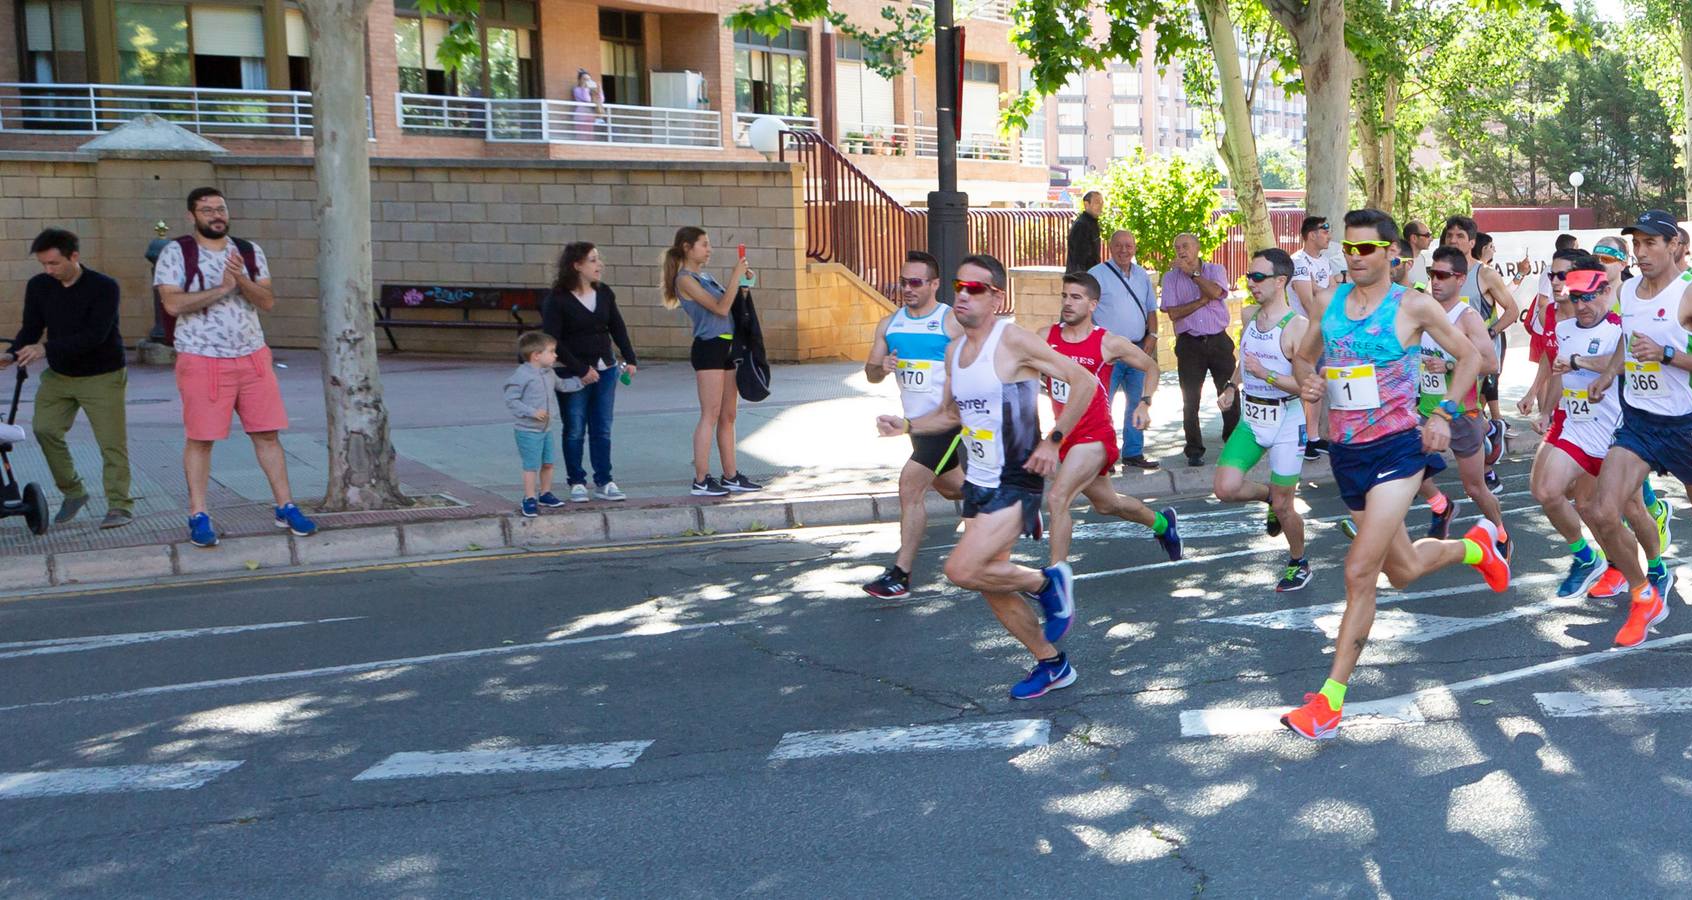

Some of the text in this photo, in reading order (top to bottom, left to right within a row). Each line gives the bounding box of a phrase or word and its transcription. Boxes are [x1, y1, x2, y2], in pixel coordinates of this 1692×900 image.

[900, 371, 924, 385] 170
[1631, 374, 1658, 391] 366
[1053, 381, 1066, 396] 31
[1342, 382, 1352, 400] 1
[1245, 403, 1277, 421] 3211
